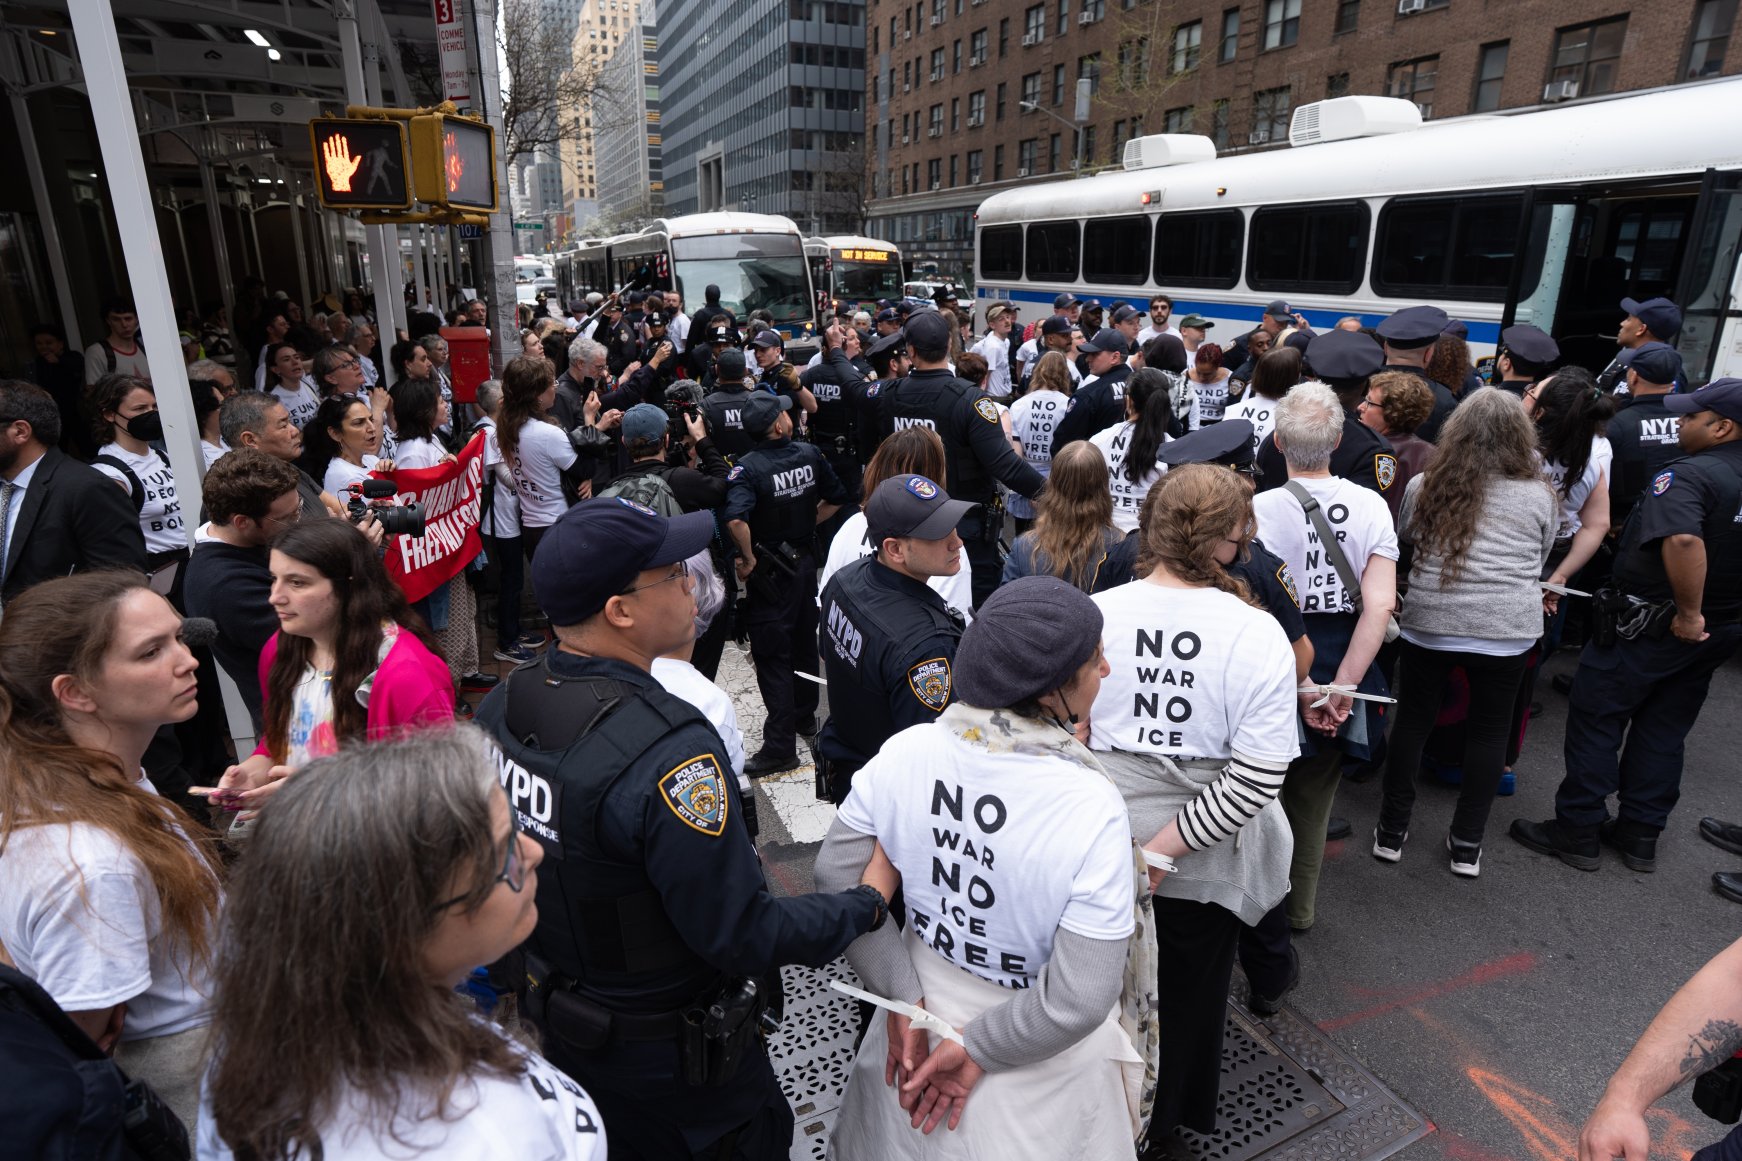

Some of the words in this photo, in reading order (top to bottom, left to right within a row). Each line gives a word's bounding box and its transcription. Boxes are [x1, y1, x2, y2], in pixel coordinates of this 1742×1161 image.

[440, 0, 449, 22] 3
[841, 250, 854, 259] NOT
[854, 251, 863, 260] IN
[863, 251, 888, 261] SERVICE
[813, 383, 841, 397] NYPD
[725, 409, 743, 423] NY
[1031, 400, 1057, 411] NO
[1032, 412, 1053, 420] WAR
[1241, 406, 1270, 422] NO
[1030, 421, 1052, 433] NO
[1641, 417, 1680, 436] NYP
[1024, 442, 1049, 454] FRE
[773, 464, 814, 491] NYPD
[1111, 484, 1132, 494] ICE
[1308, 530, 1347, 543] WR
[1308, 573, 1336, 589] ICE
[828, 599, 863, 660] NYPD
[1135, 629, 1202, 661] NO
[913, 667, 947, 682] DEPARTMENT
[918, 662, 939, 674] POLICE
[1137, 667, 1195, 689] WAR
[1133, 692, 1193, 723] NO
[1137, 727, 1183, 748] ICE
[669, 766, 717, 799] DEPARTMENT
[674, 761, 705, 783] POLICE
[497, 747, 553, 824] YPD
[717, 776, 725, 802] YORK
[677, 805, 696, 822] CITY
[695, 819, 709, 828] OF
[717, 803, 725, 822] NEW
[931, 779, 1008, 835] NO
[932, 827, 995, 872] WAR
[931, 856, 995, 910] NO
[941, 896, 987, 937] ICE
[911, 907, 1028, 975] FREE
